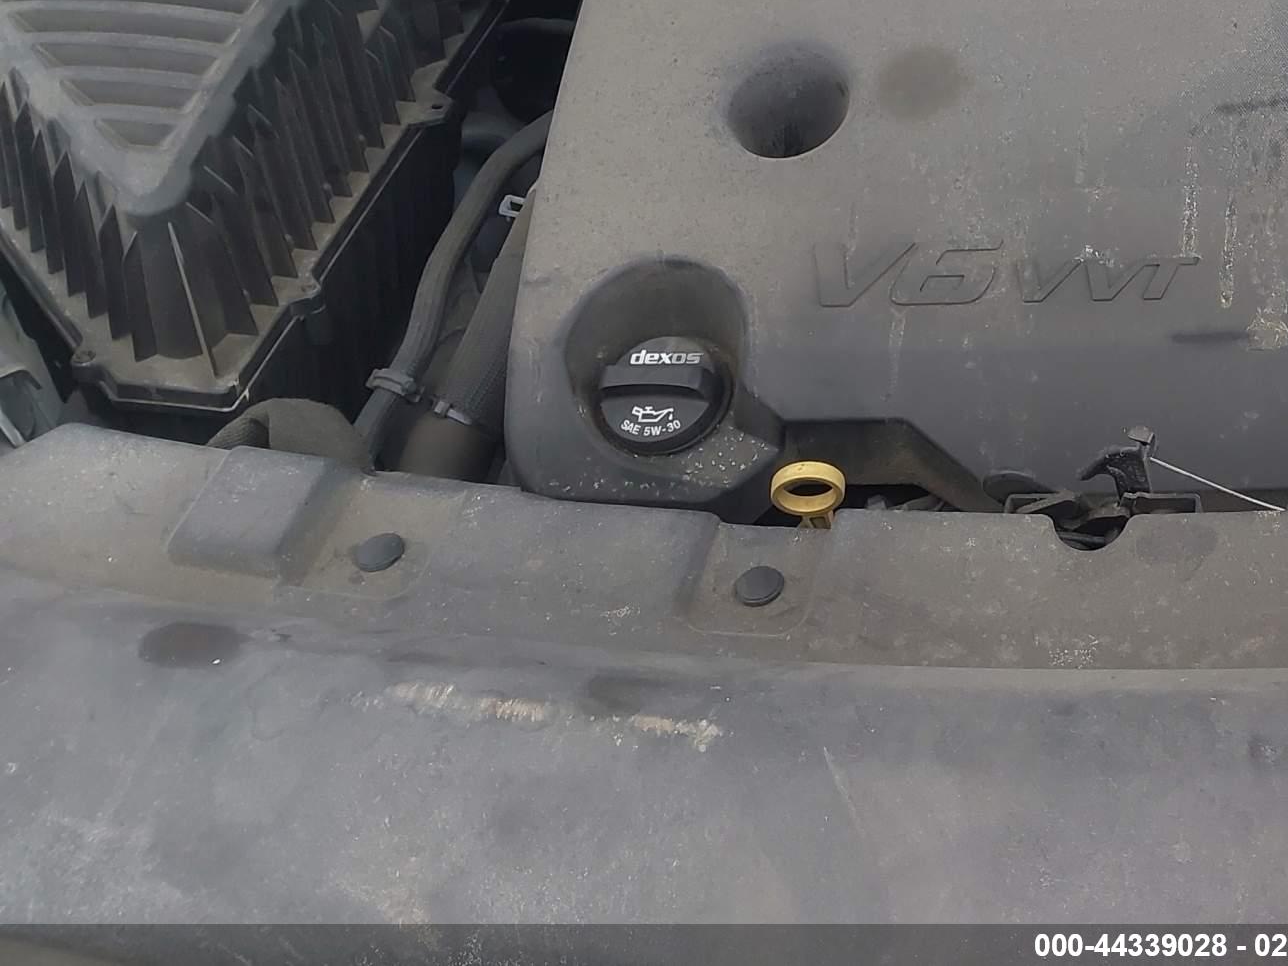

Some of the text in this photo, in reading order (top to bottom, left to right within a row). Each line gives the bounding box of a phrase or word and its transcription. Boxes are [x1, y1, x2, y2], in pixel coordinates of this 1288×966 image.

[813, 239, 1201, 308] V6 VVT
[630, 349, 704, 365] dexos
[620, 419, 682, 436] SAE 5W-30
